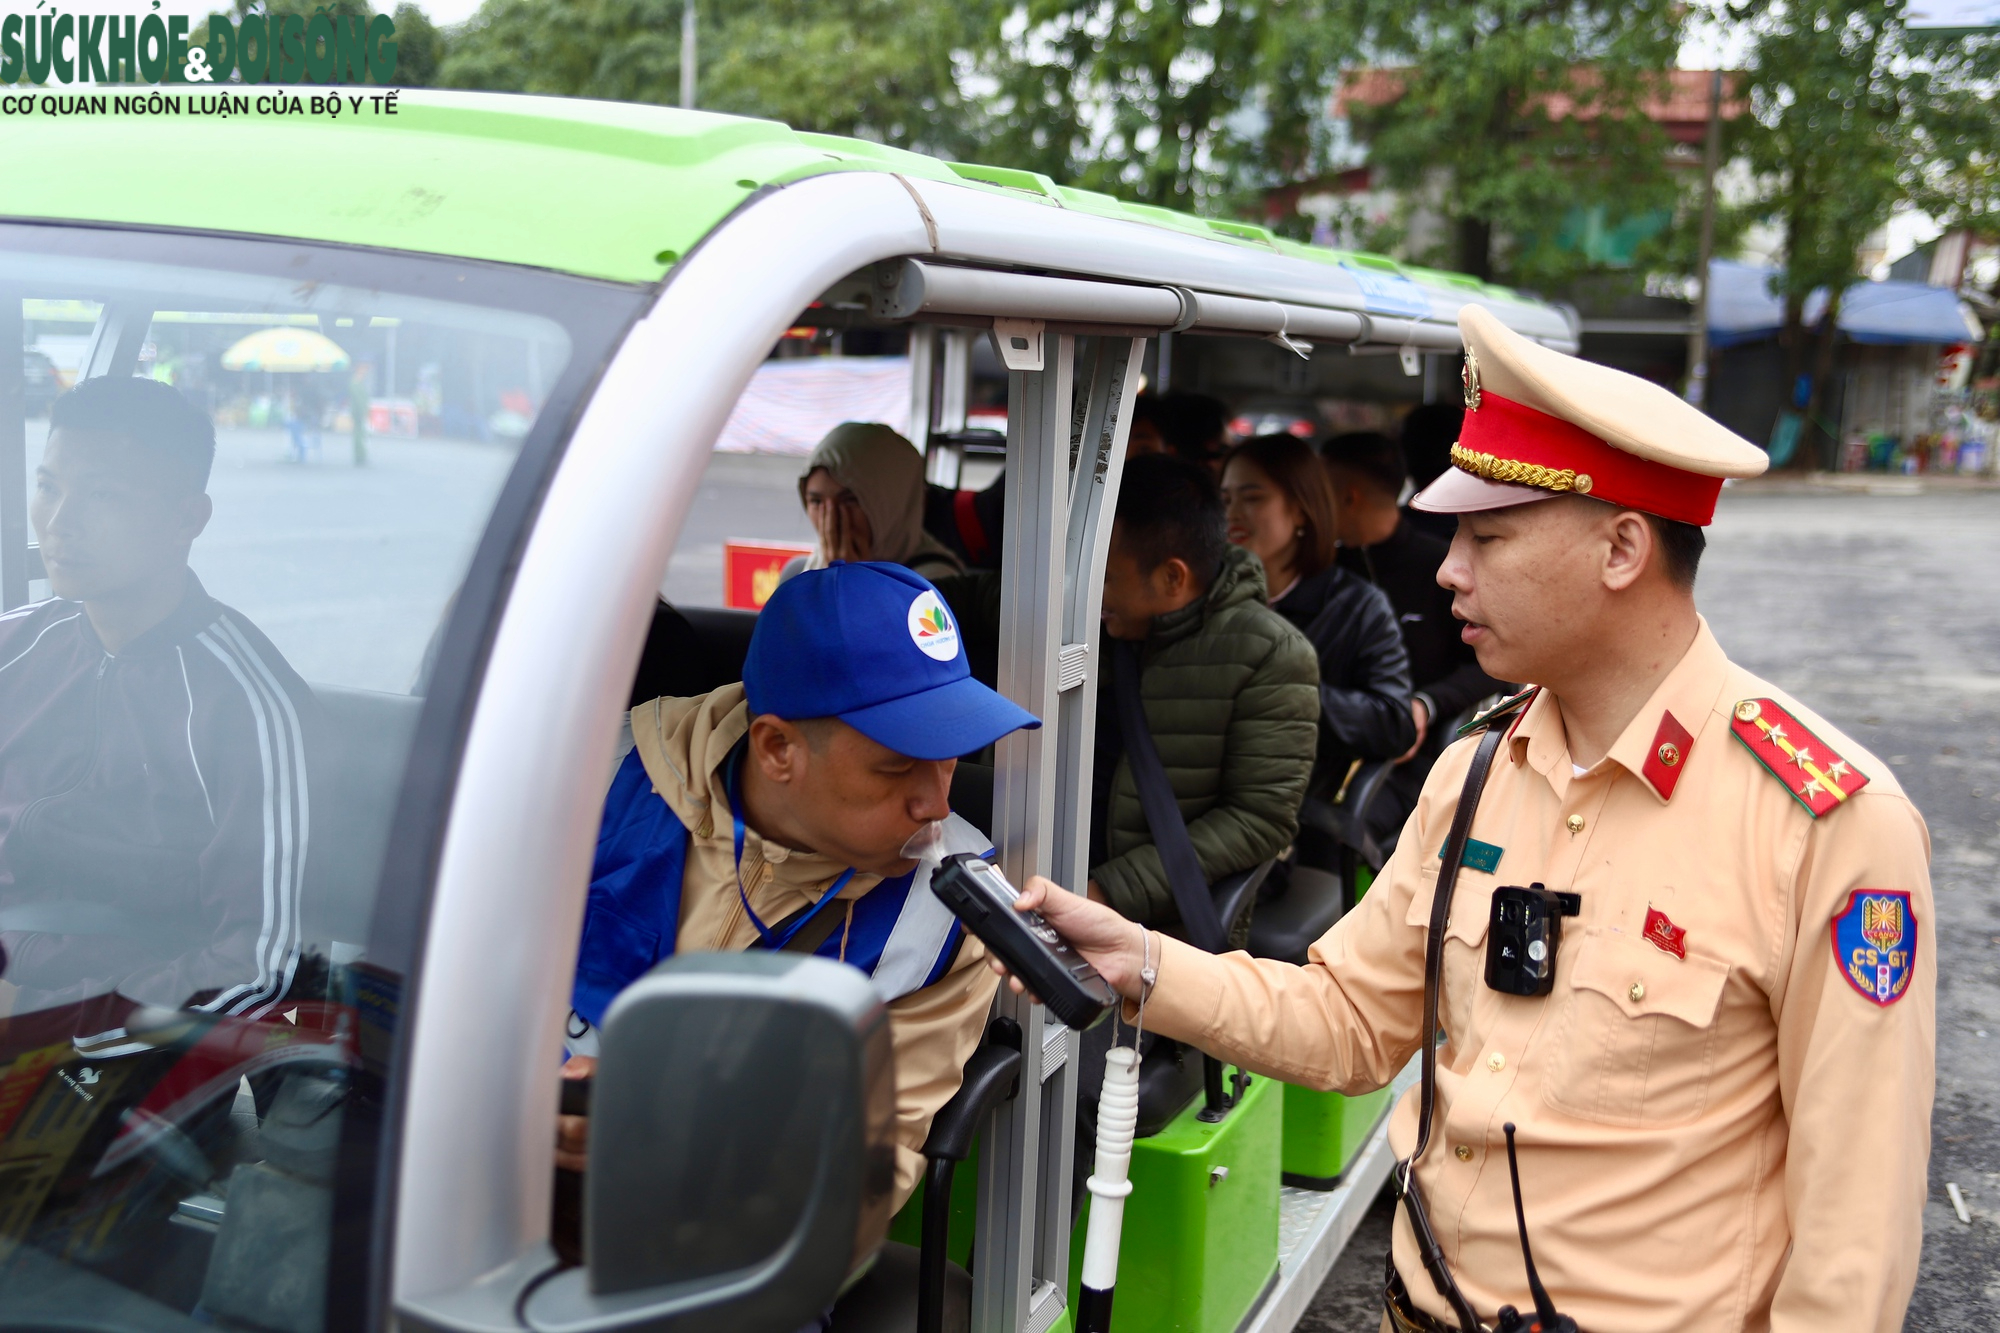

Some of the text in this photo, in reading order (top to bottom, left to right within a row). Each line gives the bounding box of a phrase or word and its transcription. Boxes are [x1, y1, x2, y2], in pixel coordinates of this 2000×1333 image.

[57, 1068, 94, 1102] le coq sportif
